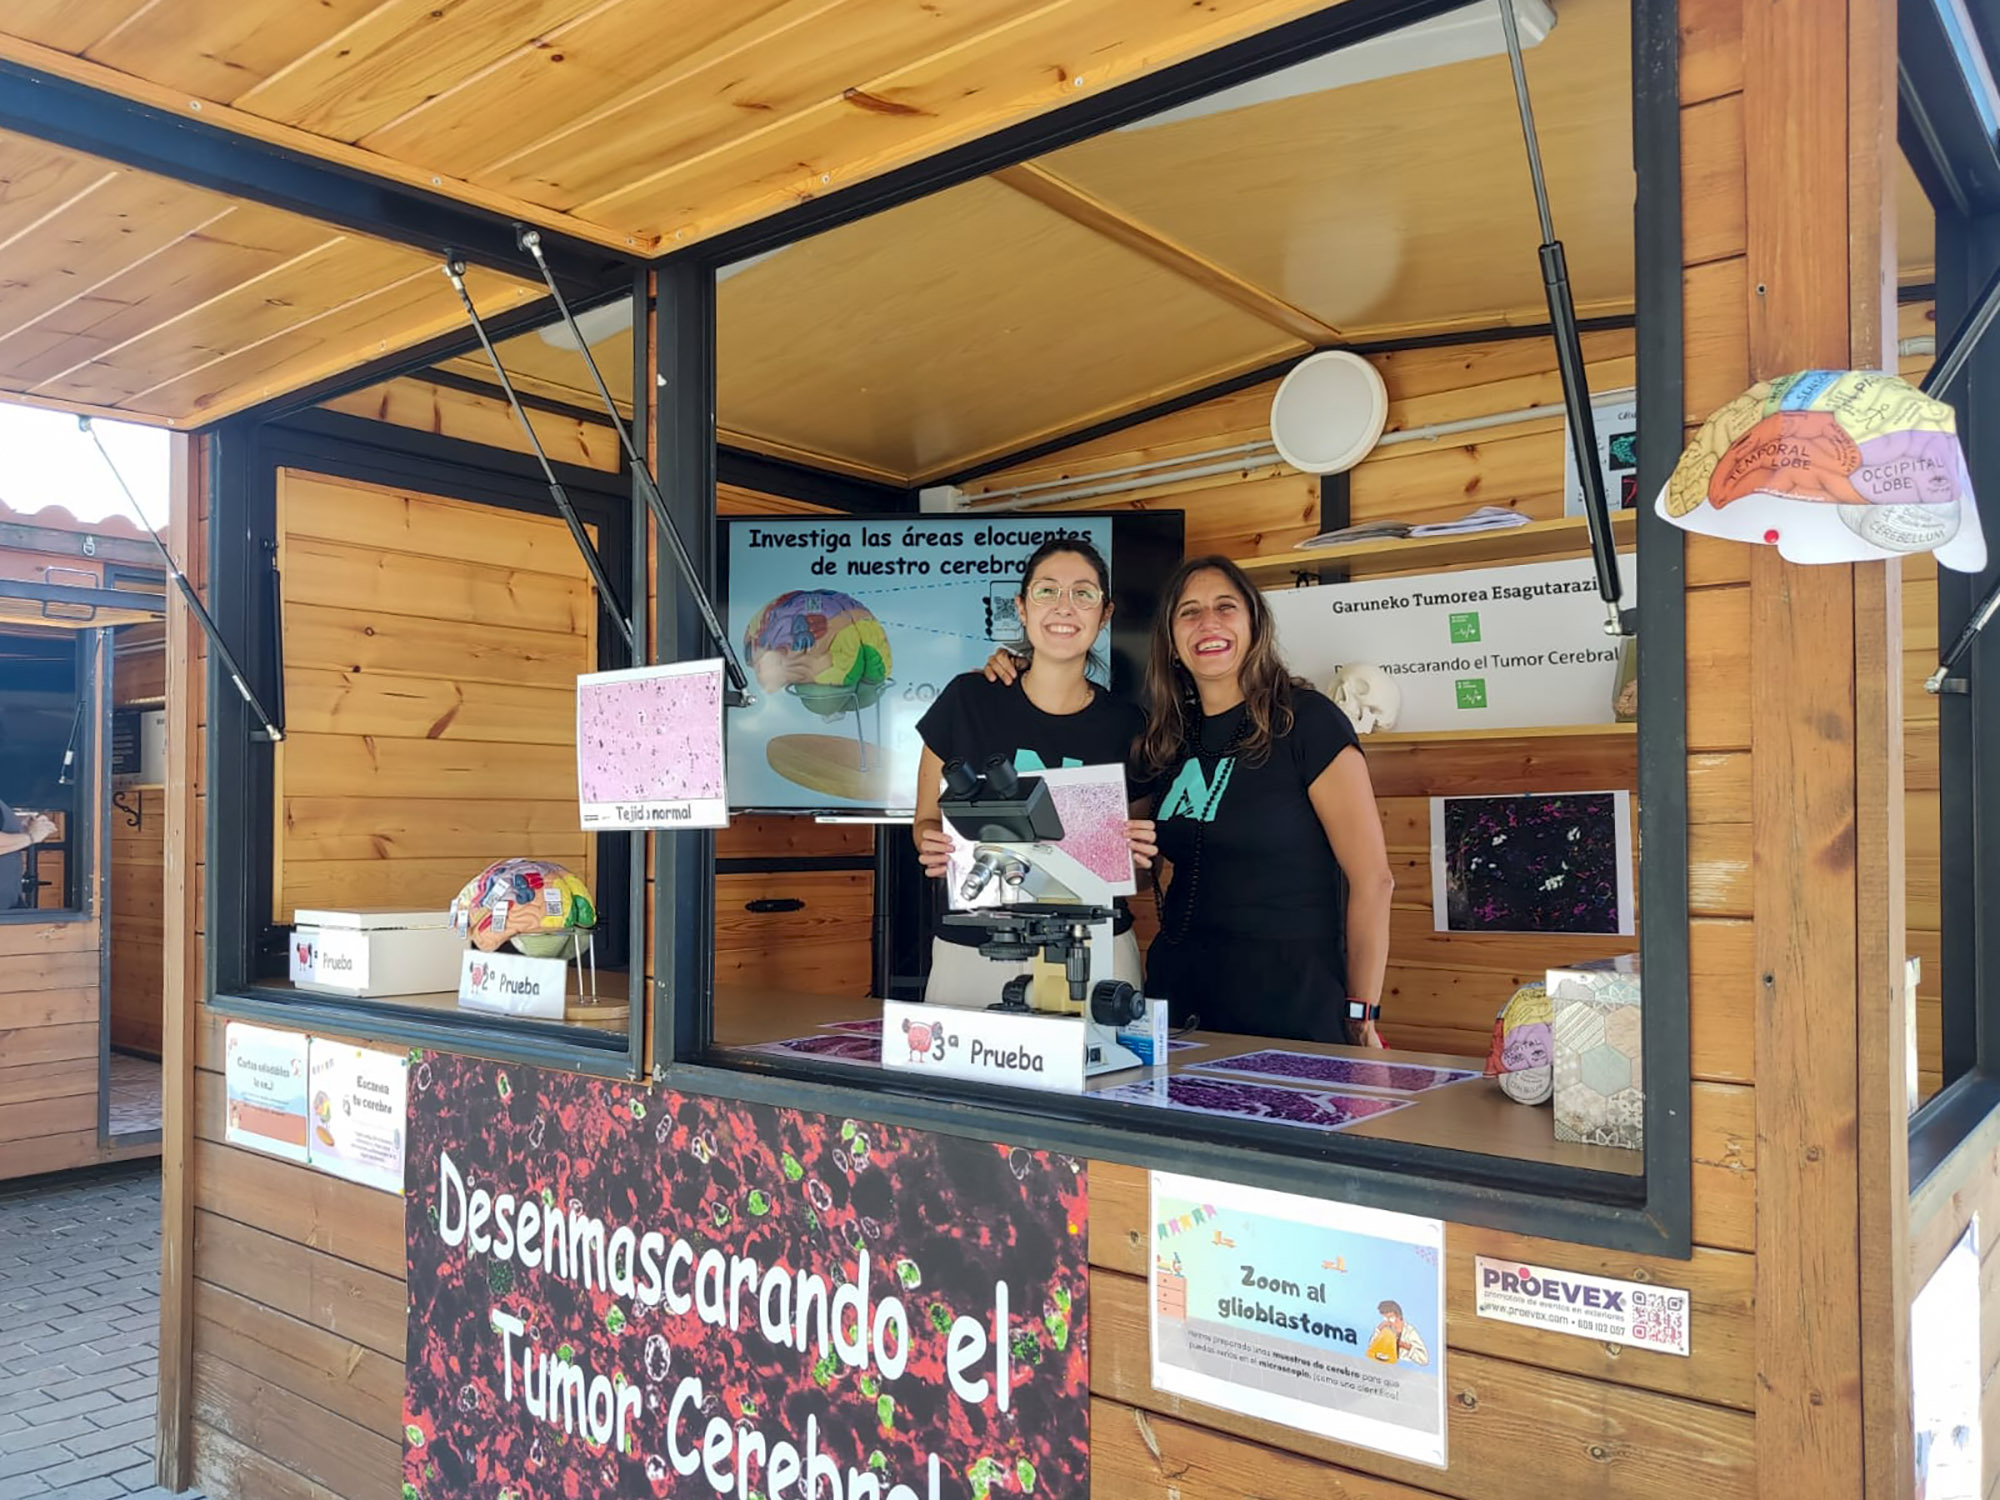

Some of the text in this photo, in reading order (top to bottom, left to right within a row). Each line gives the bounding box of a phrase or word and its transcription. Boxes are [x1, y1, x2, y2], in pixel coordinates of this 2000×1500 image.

[1730, 443, 1811, 481] TEMPORAL
[1771, 458, 1811, 470] LOBE
[1862, 458, 1945, 482] OCCIPITAL
[1872, 477, 1913, 494] LOBE
[749, 529, 851, 552] Investiga
[862, 527, 891, 547] las
[902, 526, 964, 547] áreas
[1869, 521, 1946, 544] CEREBELLUM
[811, 555, 1028, 576] de nuestro cerebro
[1332, 576, 1598, 614] Garuneko Tumorea Esagutarazi
[1474, 656, 1488, 671] el
[1490, 650, 1545, 669] Tumor
[1547, 646, 1620, 666] Cerebral
[652, 804, 692, 820] normal
[323, 954, 352, 971] Prueba
[500, 976, 541, 996] Prueba
[971, 1039, 1044, 1072] Prueba
[357, 1075, 390, 1095] Escanea
[353, 1094, 393, 1115] tu cerebro
[439, 1152, 1009, 1412] Desenmascarando el
[1240, 1265, 1326, 1304] Zoom al
[1484, 1267, 1624, 1312] PROEVEX
[1217, 1296, 1358, 1345] glioblastoma
[1539, 1300, 1571, 1313] eventos
[1584, 1309, 1625, 1323] exteriores
[1326, 1366, 1360, 1379] cerebro
[492, 1309, 942, 1500] Tumor Cereb
